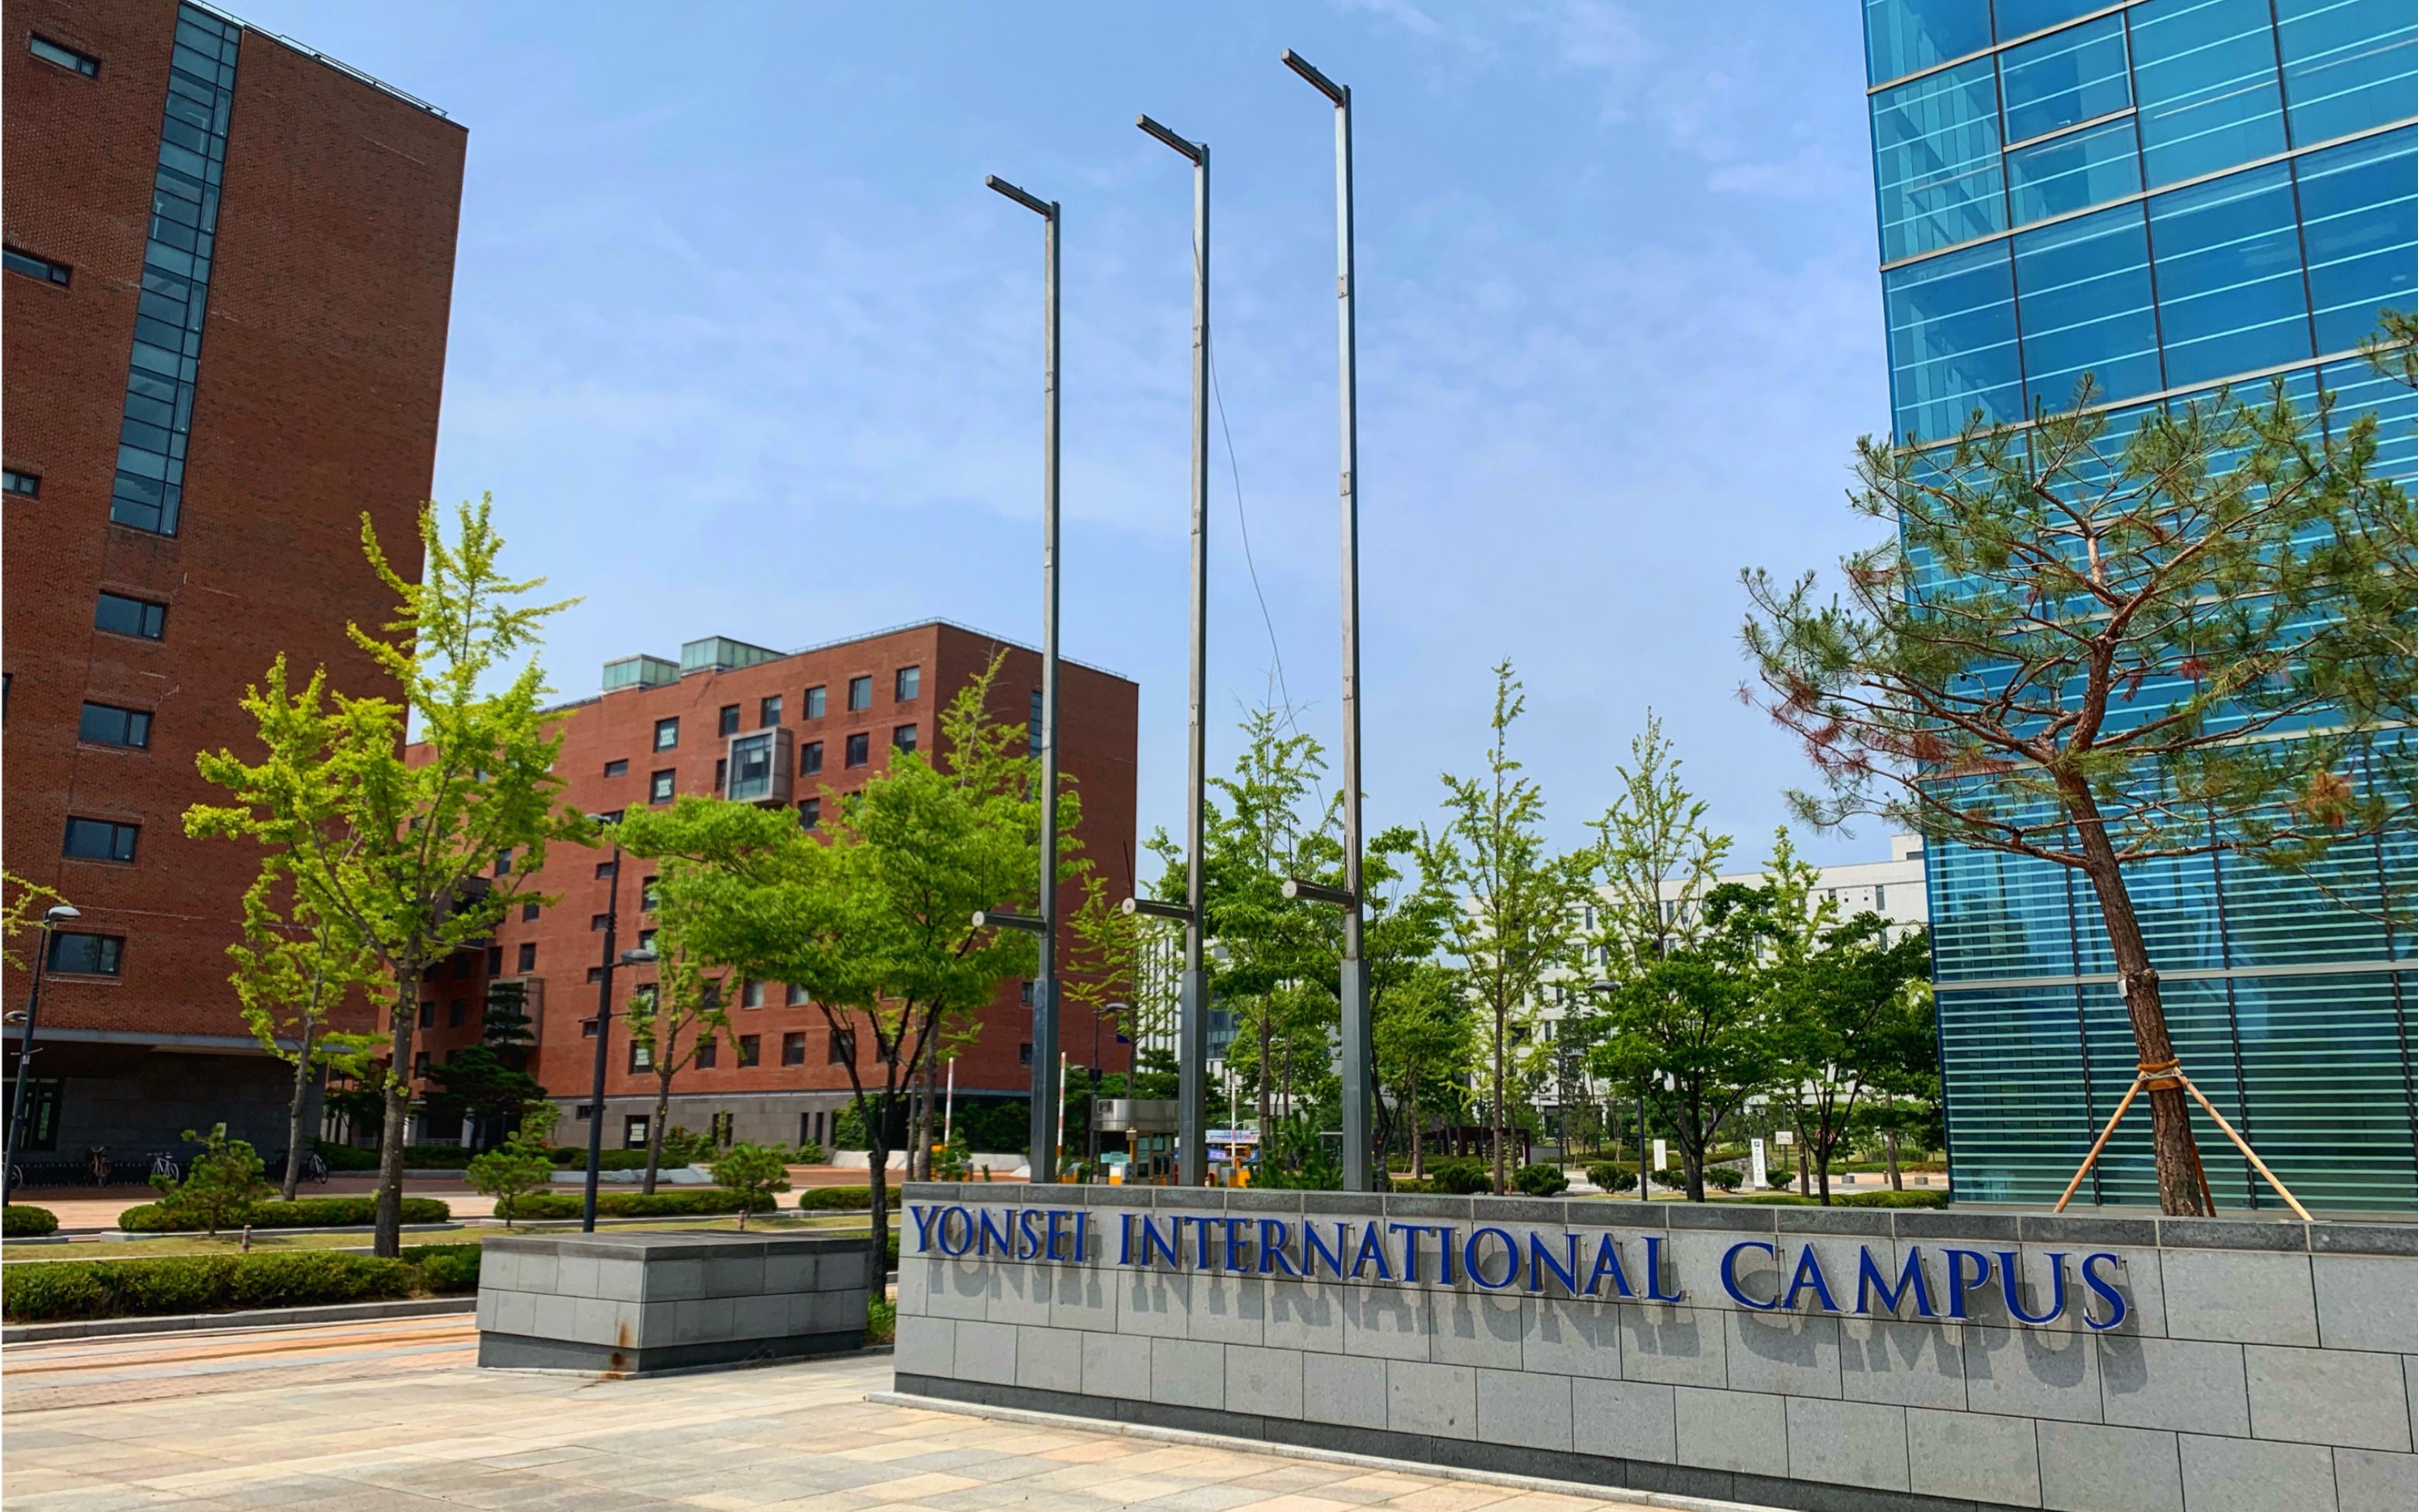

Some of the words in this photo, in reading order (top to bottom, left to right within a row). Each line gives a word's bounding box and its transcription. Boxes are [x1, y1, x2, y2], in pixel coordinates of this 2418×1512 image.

[909, 1204, 1087, 1262] YONSEI
[1119, 1212, 1682, 1303] INTERNATIONAL
[1719, 1241, 2128, 1330] CAMPUS
